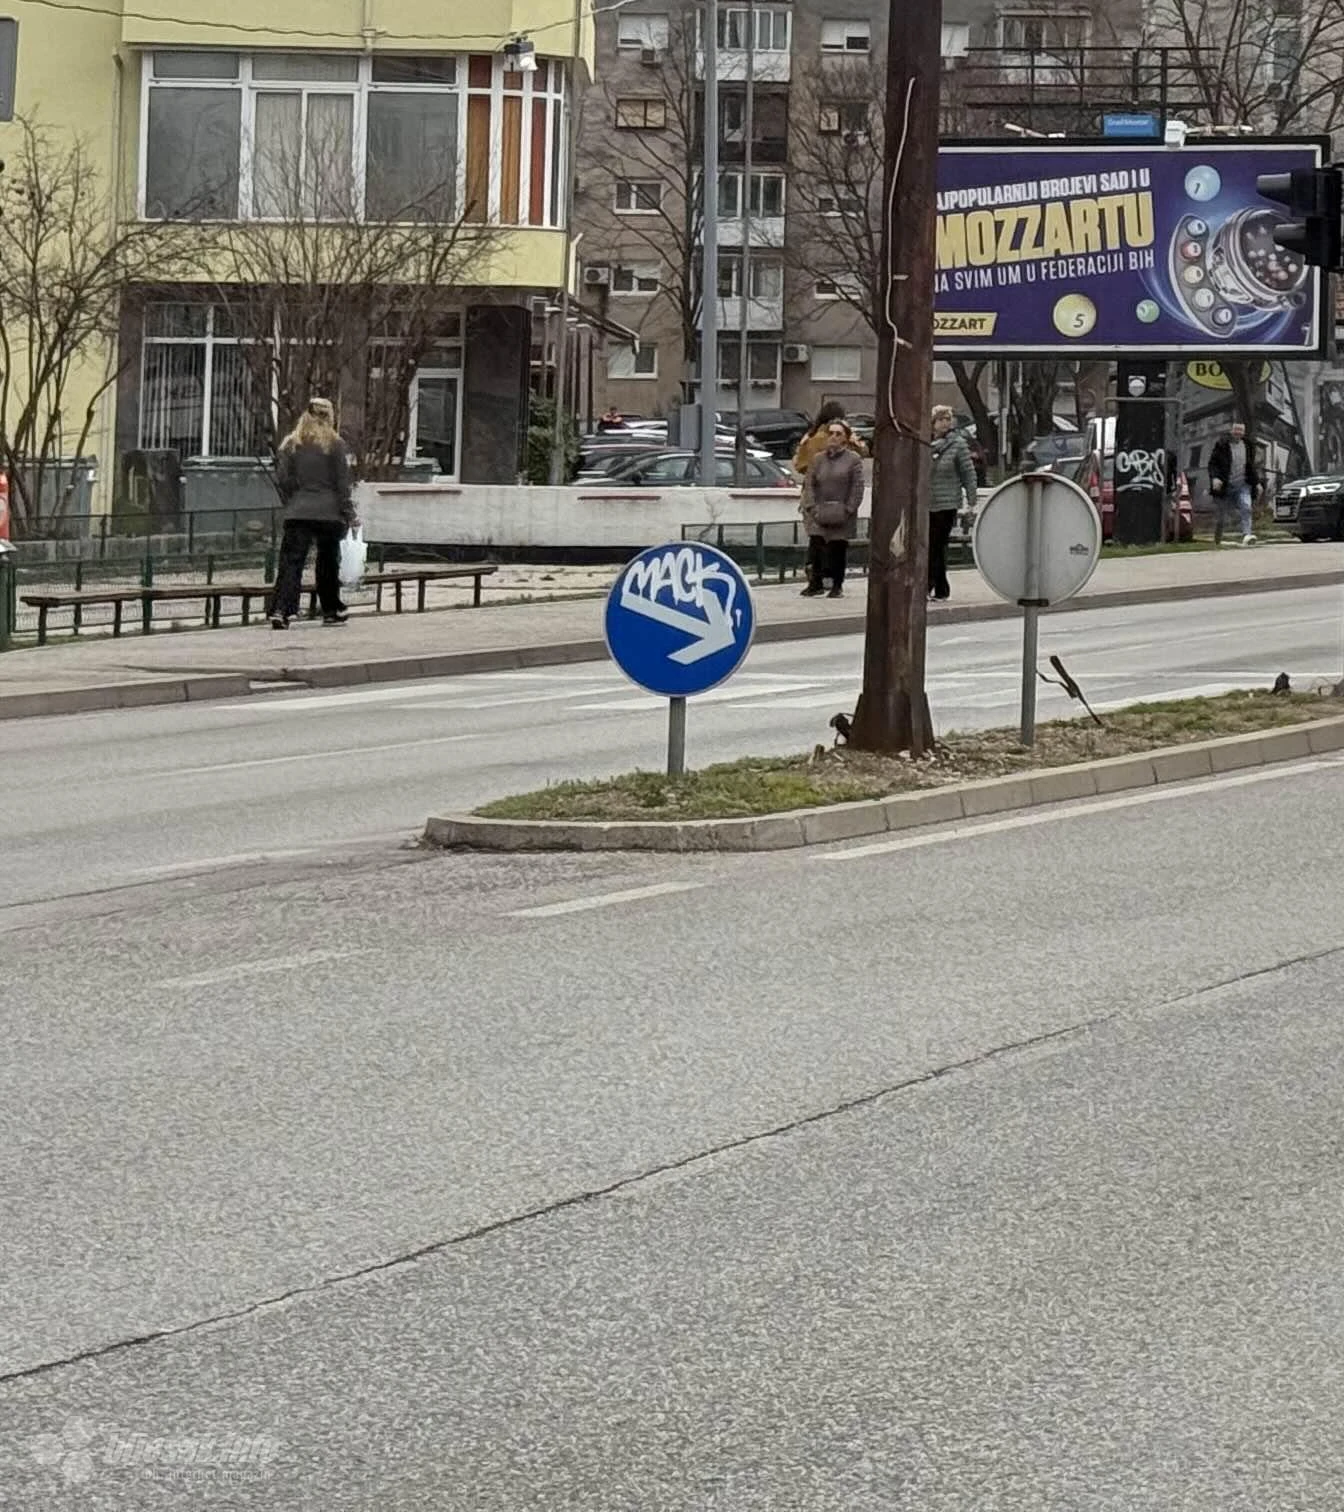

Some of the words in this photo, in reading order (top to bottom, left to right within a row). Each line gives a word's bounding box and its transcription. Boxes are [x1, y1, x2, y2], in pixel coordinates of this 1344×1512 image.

[936, 181, 1038, 211] AJPOPULARNIJI
[1041, 174, 1098, 199] BROJEVI
[1100, 170, 1128, 190] SAD
[1139, 168, 1150, 187] U
[935, 191, 1155, 271] MOZZARTU
[955, 267, 993, 289] SVIM
[998, 265, 1021, 286] UM
[1026, 263, 1036, 281] U
[1041, 253, 1125, 280] FEDERACIJI
[1129, 249, 1155, 270] BIH
[933, 317, 987, 330] OZZART
[1073, 313, 1086, 328] 5
